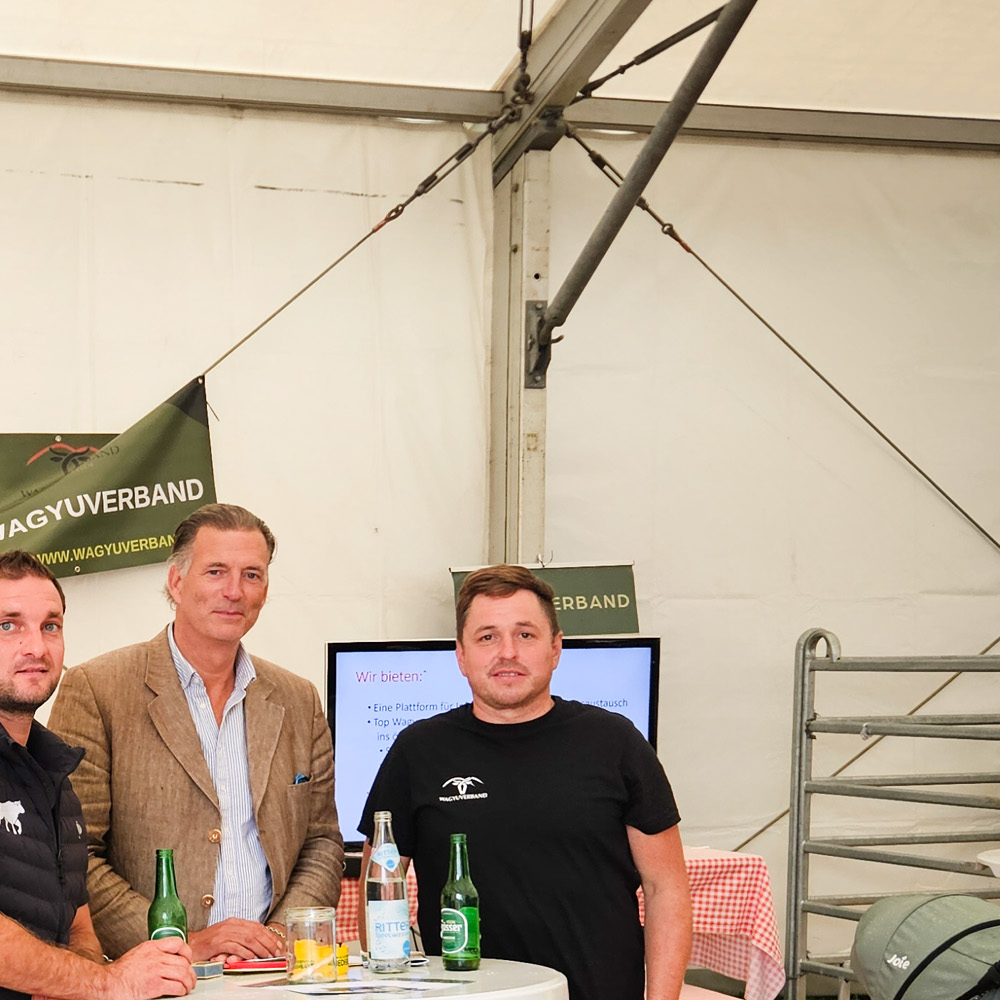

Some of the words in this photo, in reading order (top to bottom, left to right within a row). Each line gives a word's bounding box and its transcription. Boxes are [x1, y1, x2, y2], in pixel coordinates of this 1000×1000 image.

[552, 594, 630, 610] ERBAND
[356, 671, 377, 683] Wir
[381, 670, 423, 683] bieten:
[373, 703, 393, 712] Eine
[395, 702, 438, 712] Plattform
[582, 698, 628, 708] austausch
[373, 718, 390, 728] Top
[392, 718, 415, 728] Wag
[377, 732, 390, 741] ins
[438, 792, 488, 802] WAGYUVERBAND
[887, 953, 911, 970] Joie
